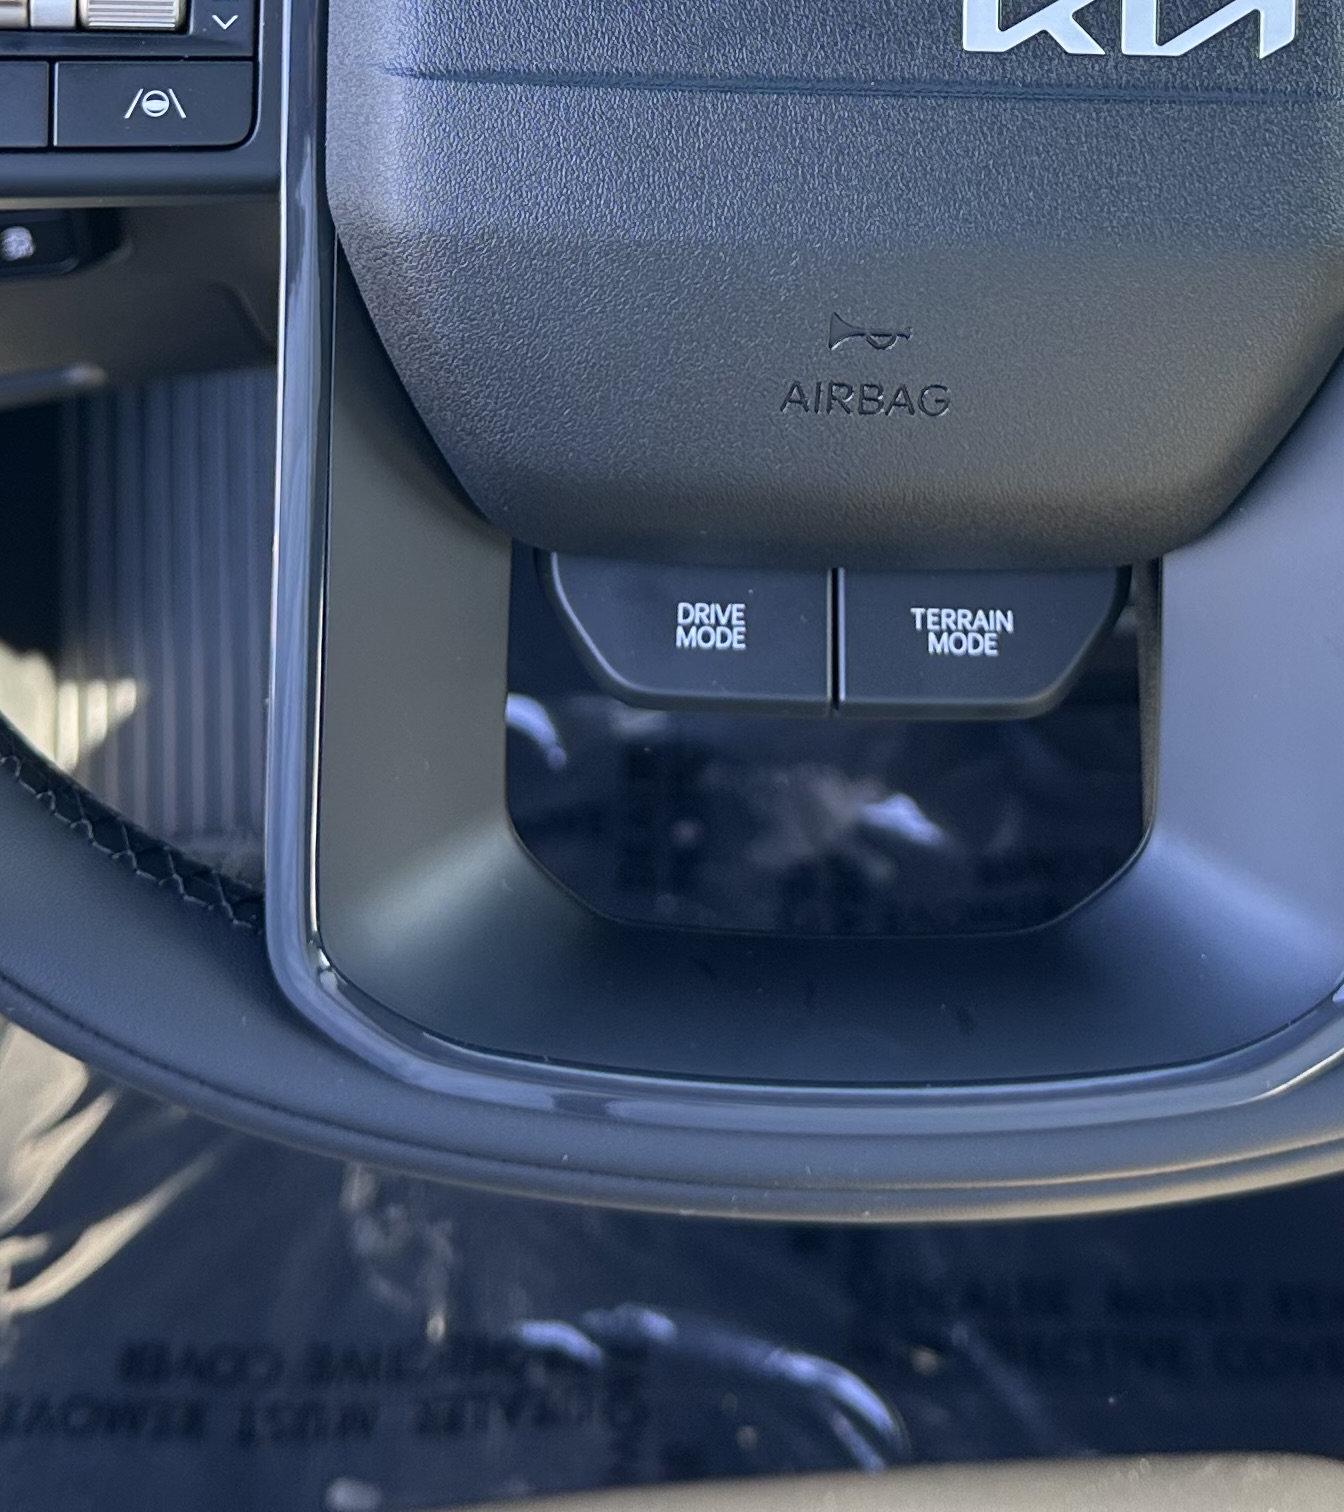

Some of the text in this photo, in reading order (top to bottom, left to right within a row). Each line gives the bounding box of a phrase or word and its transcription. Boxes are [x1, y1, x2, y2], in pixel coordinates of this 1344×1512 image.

[778, 380, 951, 419] AIRBAG
[676, 602, 747, 627] DRIVE
[910, 606, 1014, 634] TERRAIN
[675, 625, 747, 650] MODE
[927, 631, 999, 657] MODE
